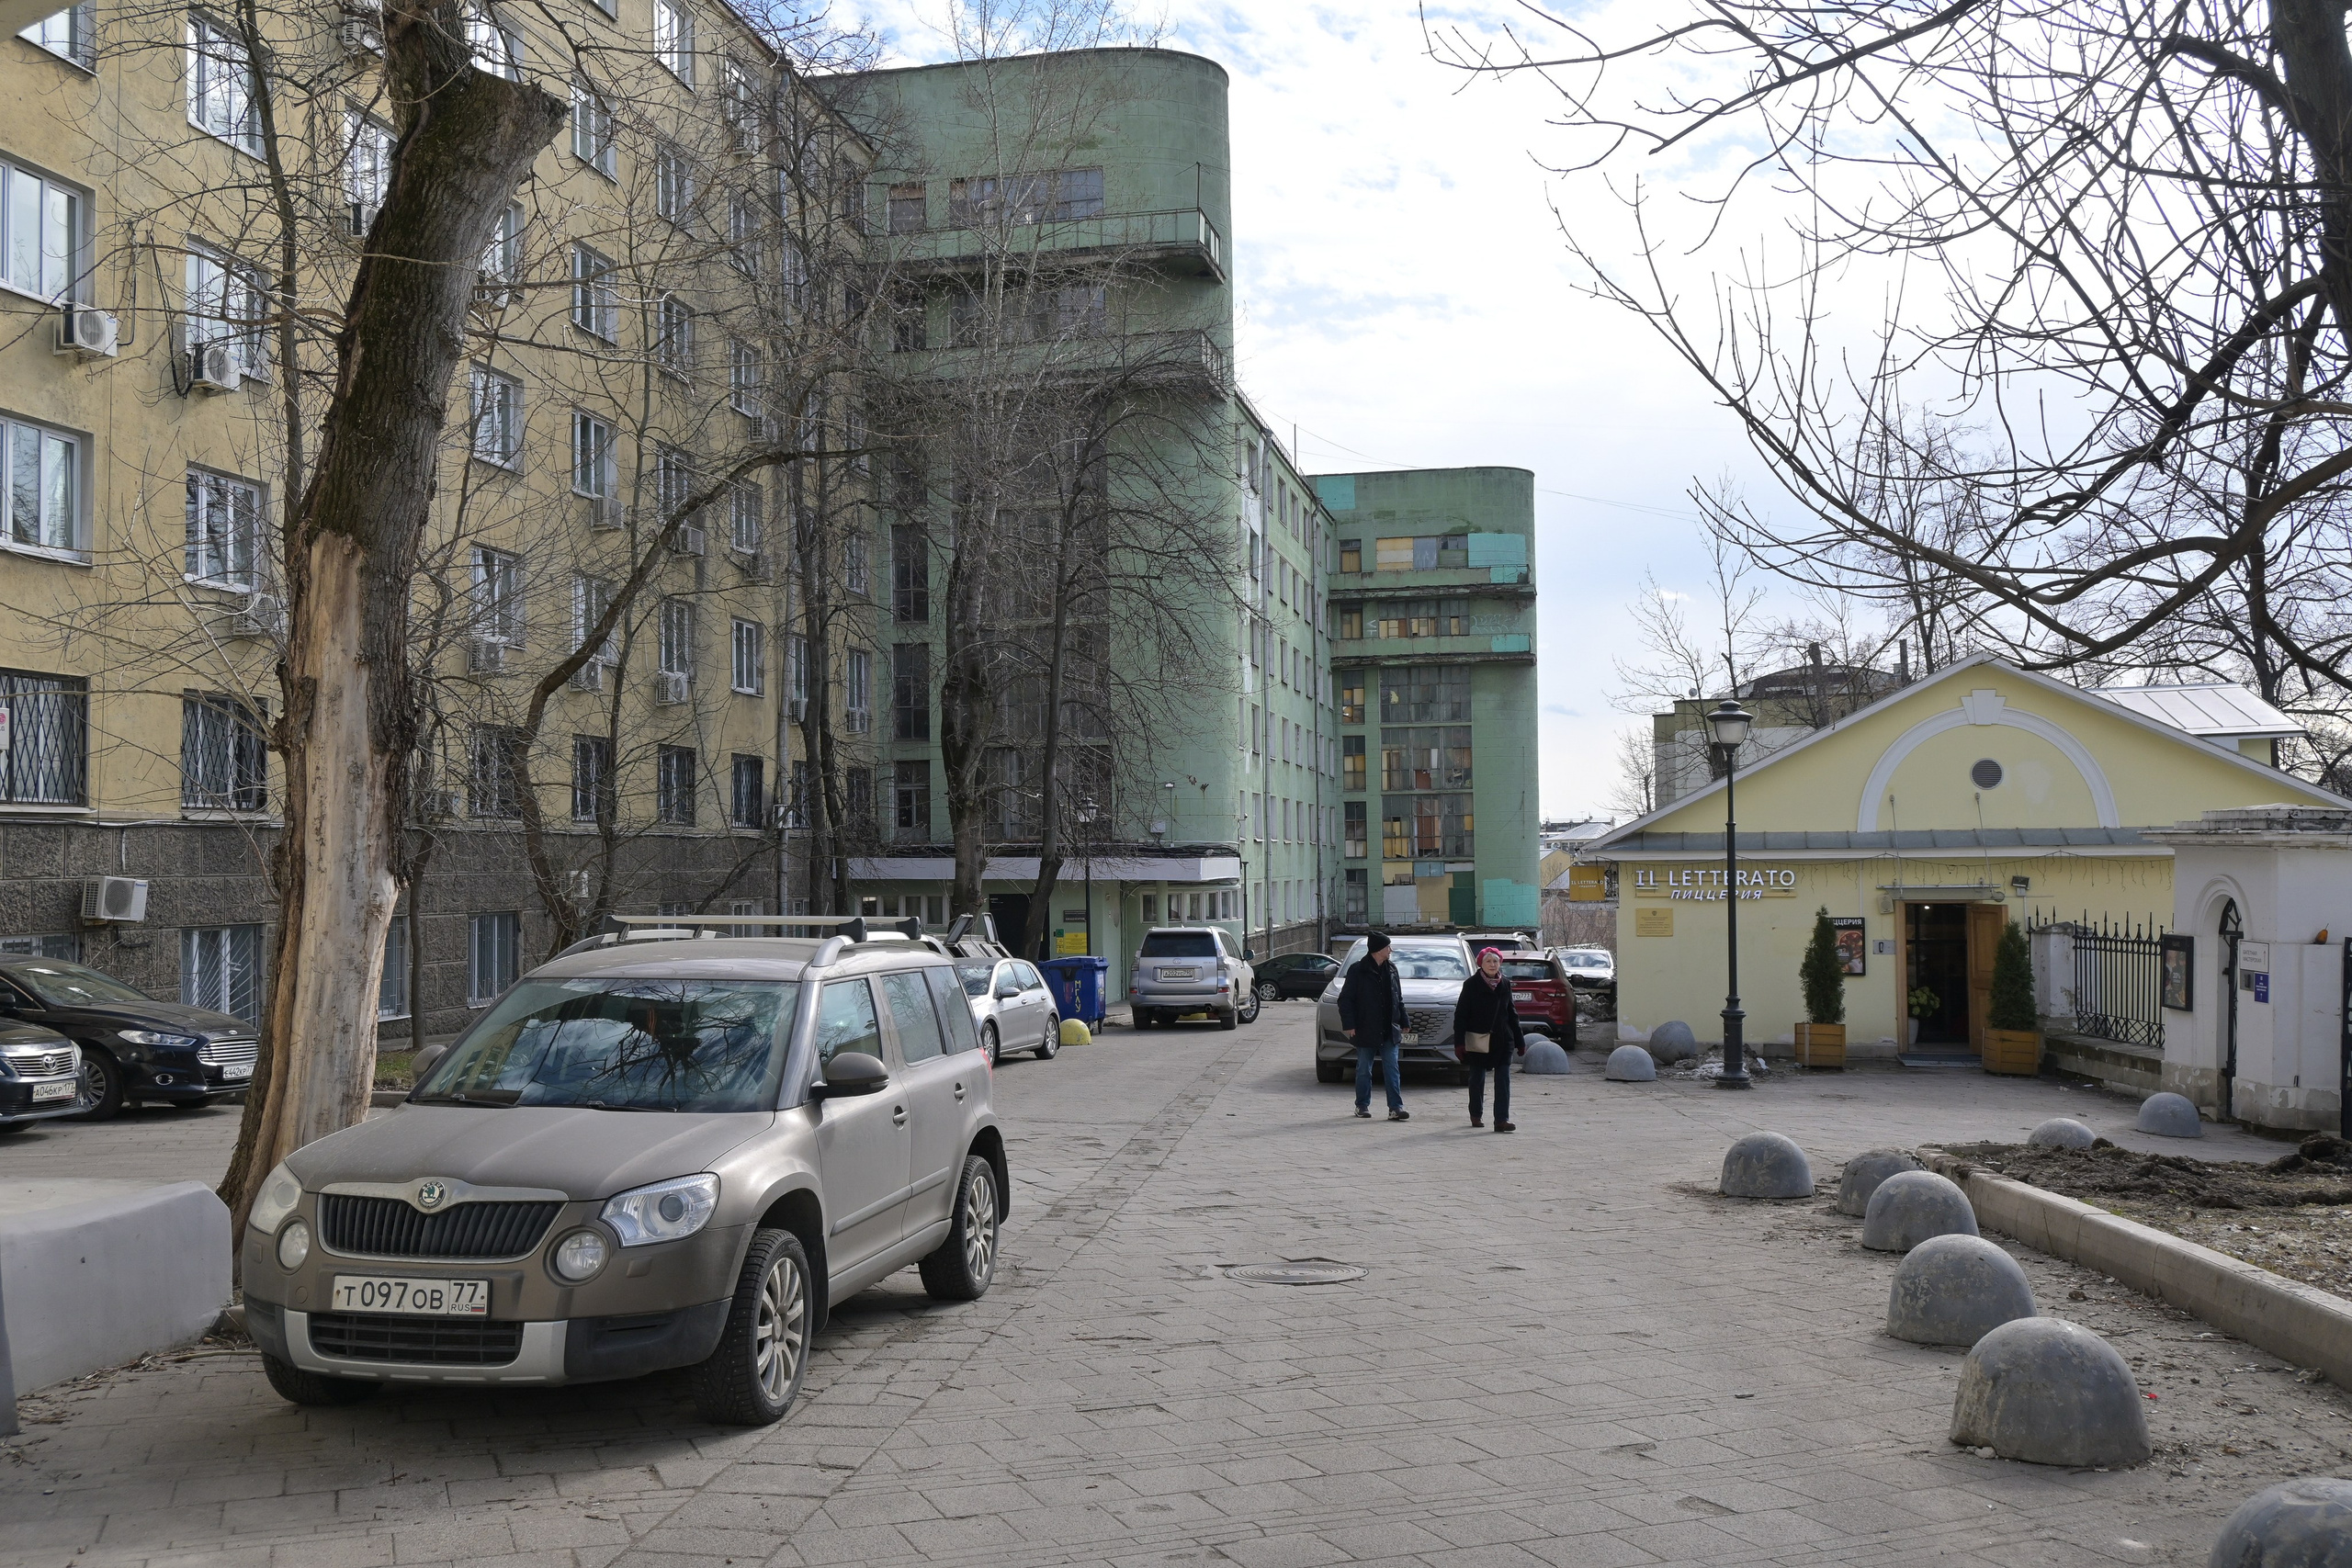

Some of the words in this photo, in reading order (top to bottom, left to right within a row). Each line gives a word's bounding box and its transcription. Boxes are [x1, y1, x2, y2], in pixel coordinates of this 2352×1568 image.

[1635, 870, 1658, 886] IL
[344, 1280, 444, 1310] Т097ОВ
[453, 1282, 479, 1303] 77
[450, 1303, 470, 1312] RUS
